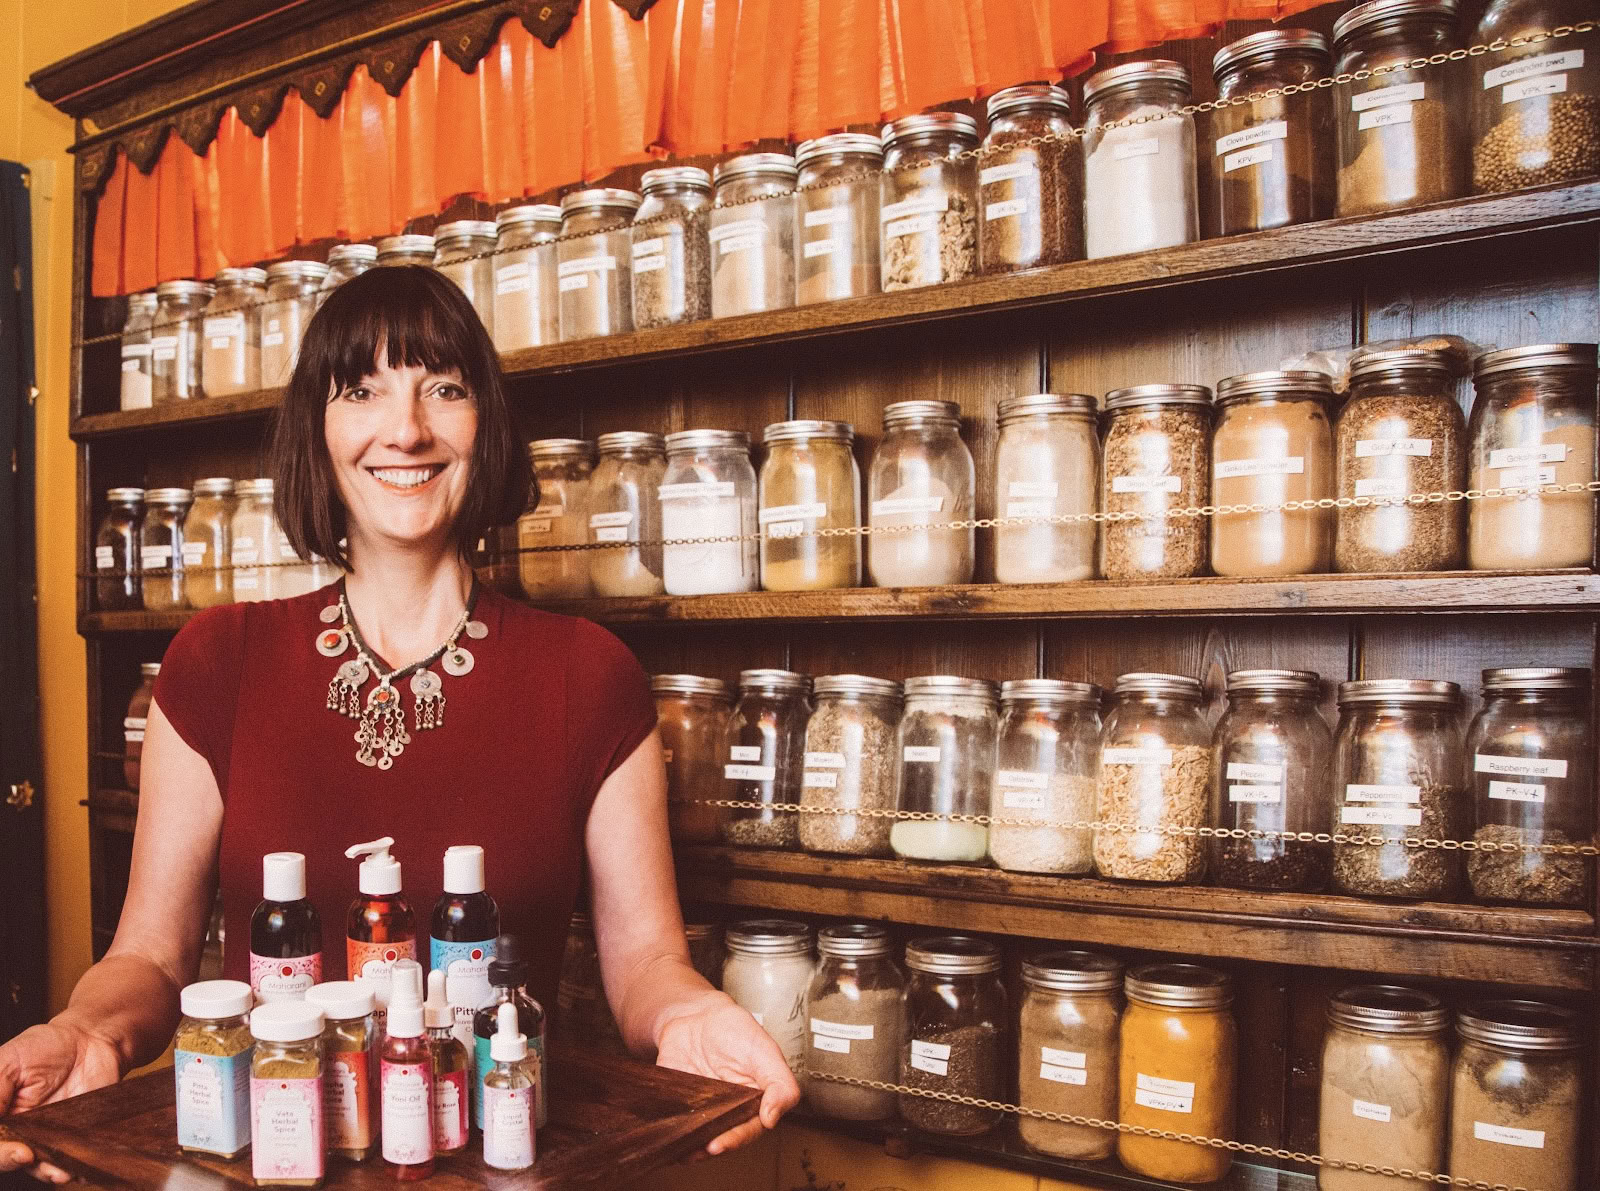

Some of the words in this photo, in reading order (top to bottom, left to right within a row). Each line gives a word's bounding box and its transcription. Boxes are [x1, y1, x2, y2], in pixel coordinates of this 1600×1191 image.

[1225, 135, 1244, 146] Clove
[1488, 762, 1530, 774] Raspberry
[1531, 766, 1549, 774] leaf
